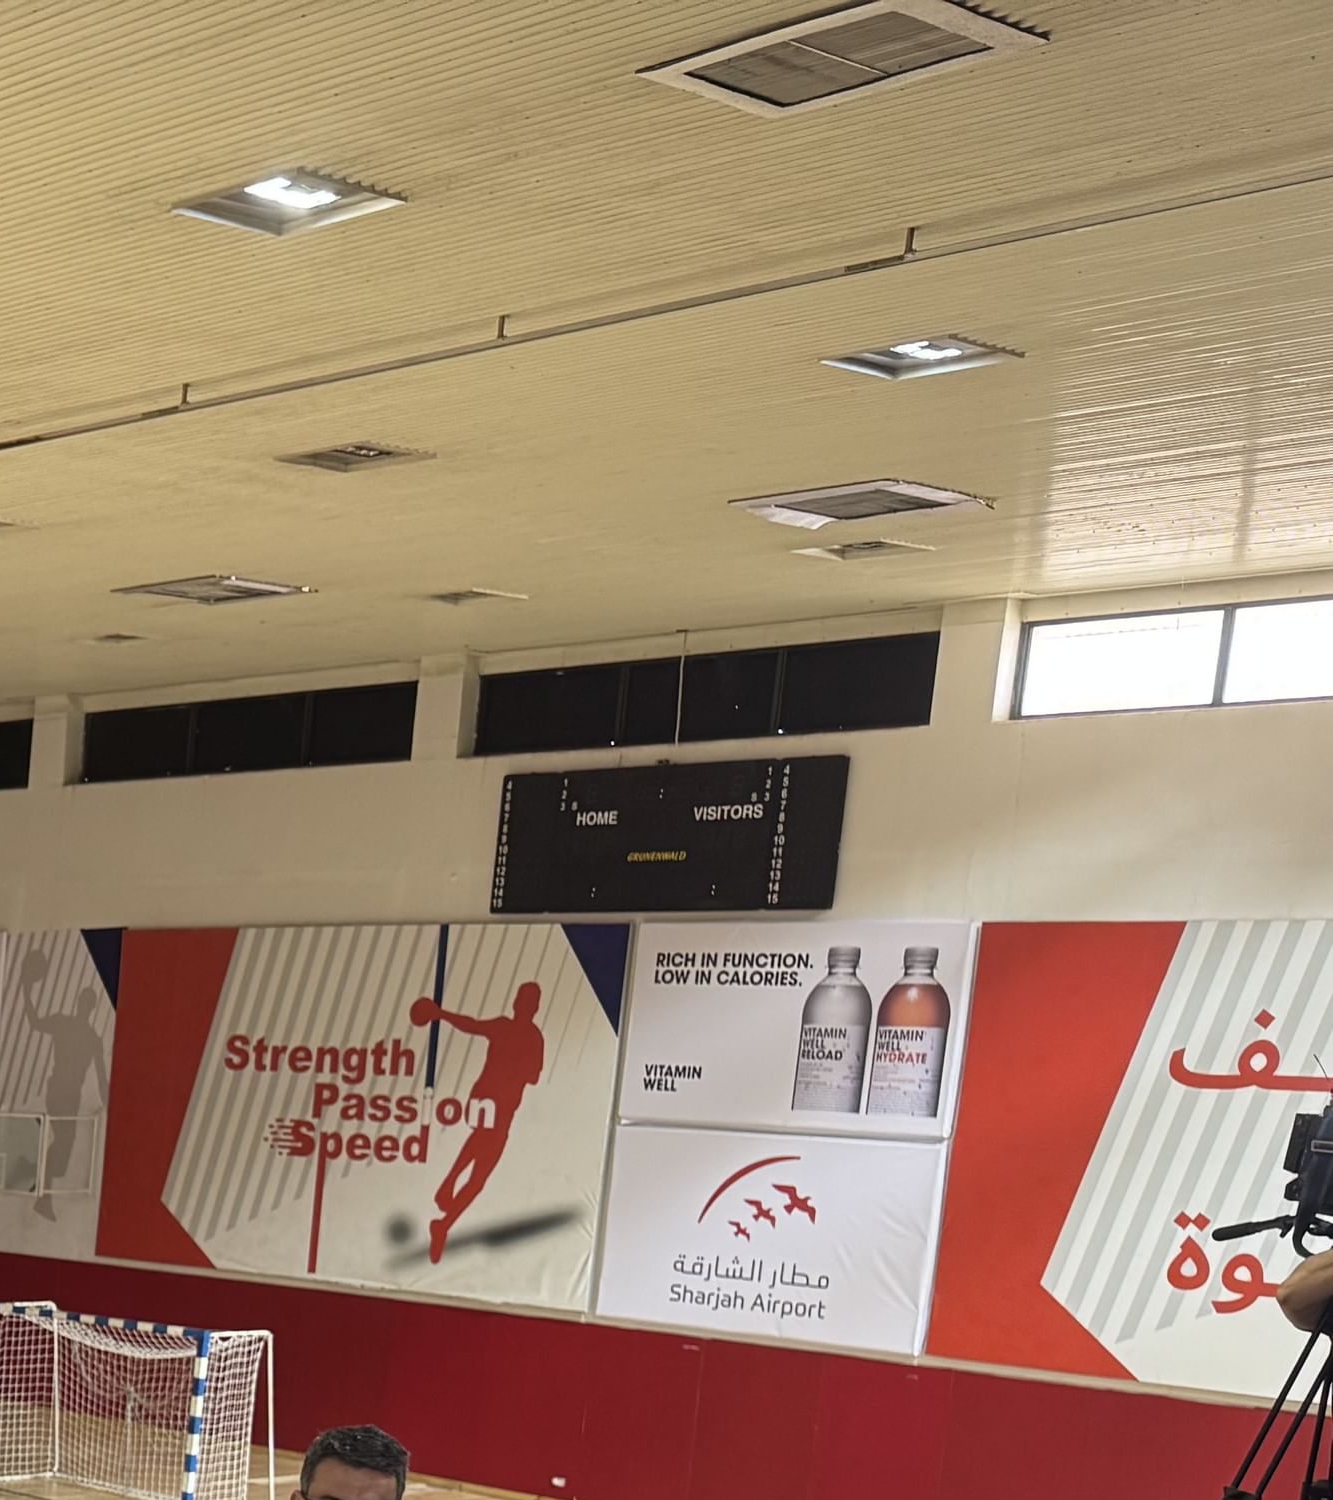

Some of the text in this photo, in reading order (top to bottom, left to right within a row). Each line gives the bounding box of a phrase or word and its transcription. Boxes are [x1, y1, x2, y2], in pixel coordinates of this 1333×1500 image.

[767, 766, 772, 776] 1
[784, 764, 790, 775] 4
[765, 779, 771, 789] 2
[575, 810, 618, 826] HOME
[693, 803, 764, 821] VISITORS
[773, 835, 784, 845] 10
[773, 847, 782, 857] 11
[771, 859, 782, 869] 12
[496, 866, 506, 876] 12
[770, 870, 781, 880] 13
[768, 882, 779, 892] 14
[767, 893, 778, 904] 15
[656, 952, 814, 969] RICH IN FUNCTION.
[654, 969, 803, 987] LOW IN CALORIES.
[803, 1027, 847, 1039] VITAMIN
[878, 1028, 924, 1042] VITAMIN
[802, 1038, 826, 1049] WELL
[877, 1040, 902, 1051] WELL
[224, 1034, 416, 1085] Strength
[800, 1049, 843, 1061] RELOAD
[875, 1051, 928, 1064] HYDRATE
[644, 1063, 703, 1080] VITAMIN
[643, 1077, 677, 1092] WELL
[311, 1082, 497, 1130] Passion
[275, 1118, 430, 1166] Speed
[673, 1253, 830, 1290] مطار الشارقة
[669, 1283, 827, 1320] Sharjah Airport
